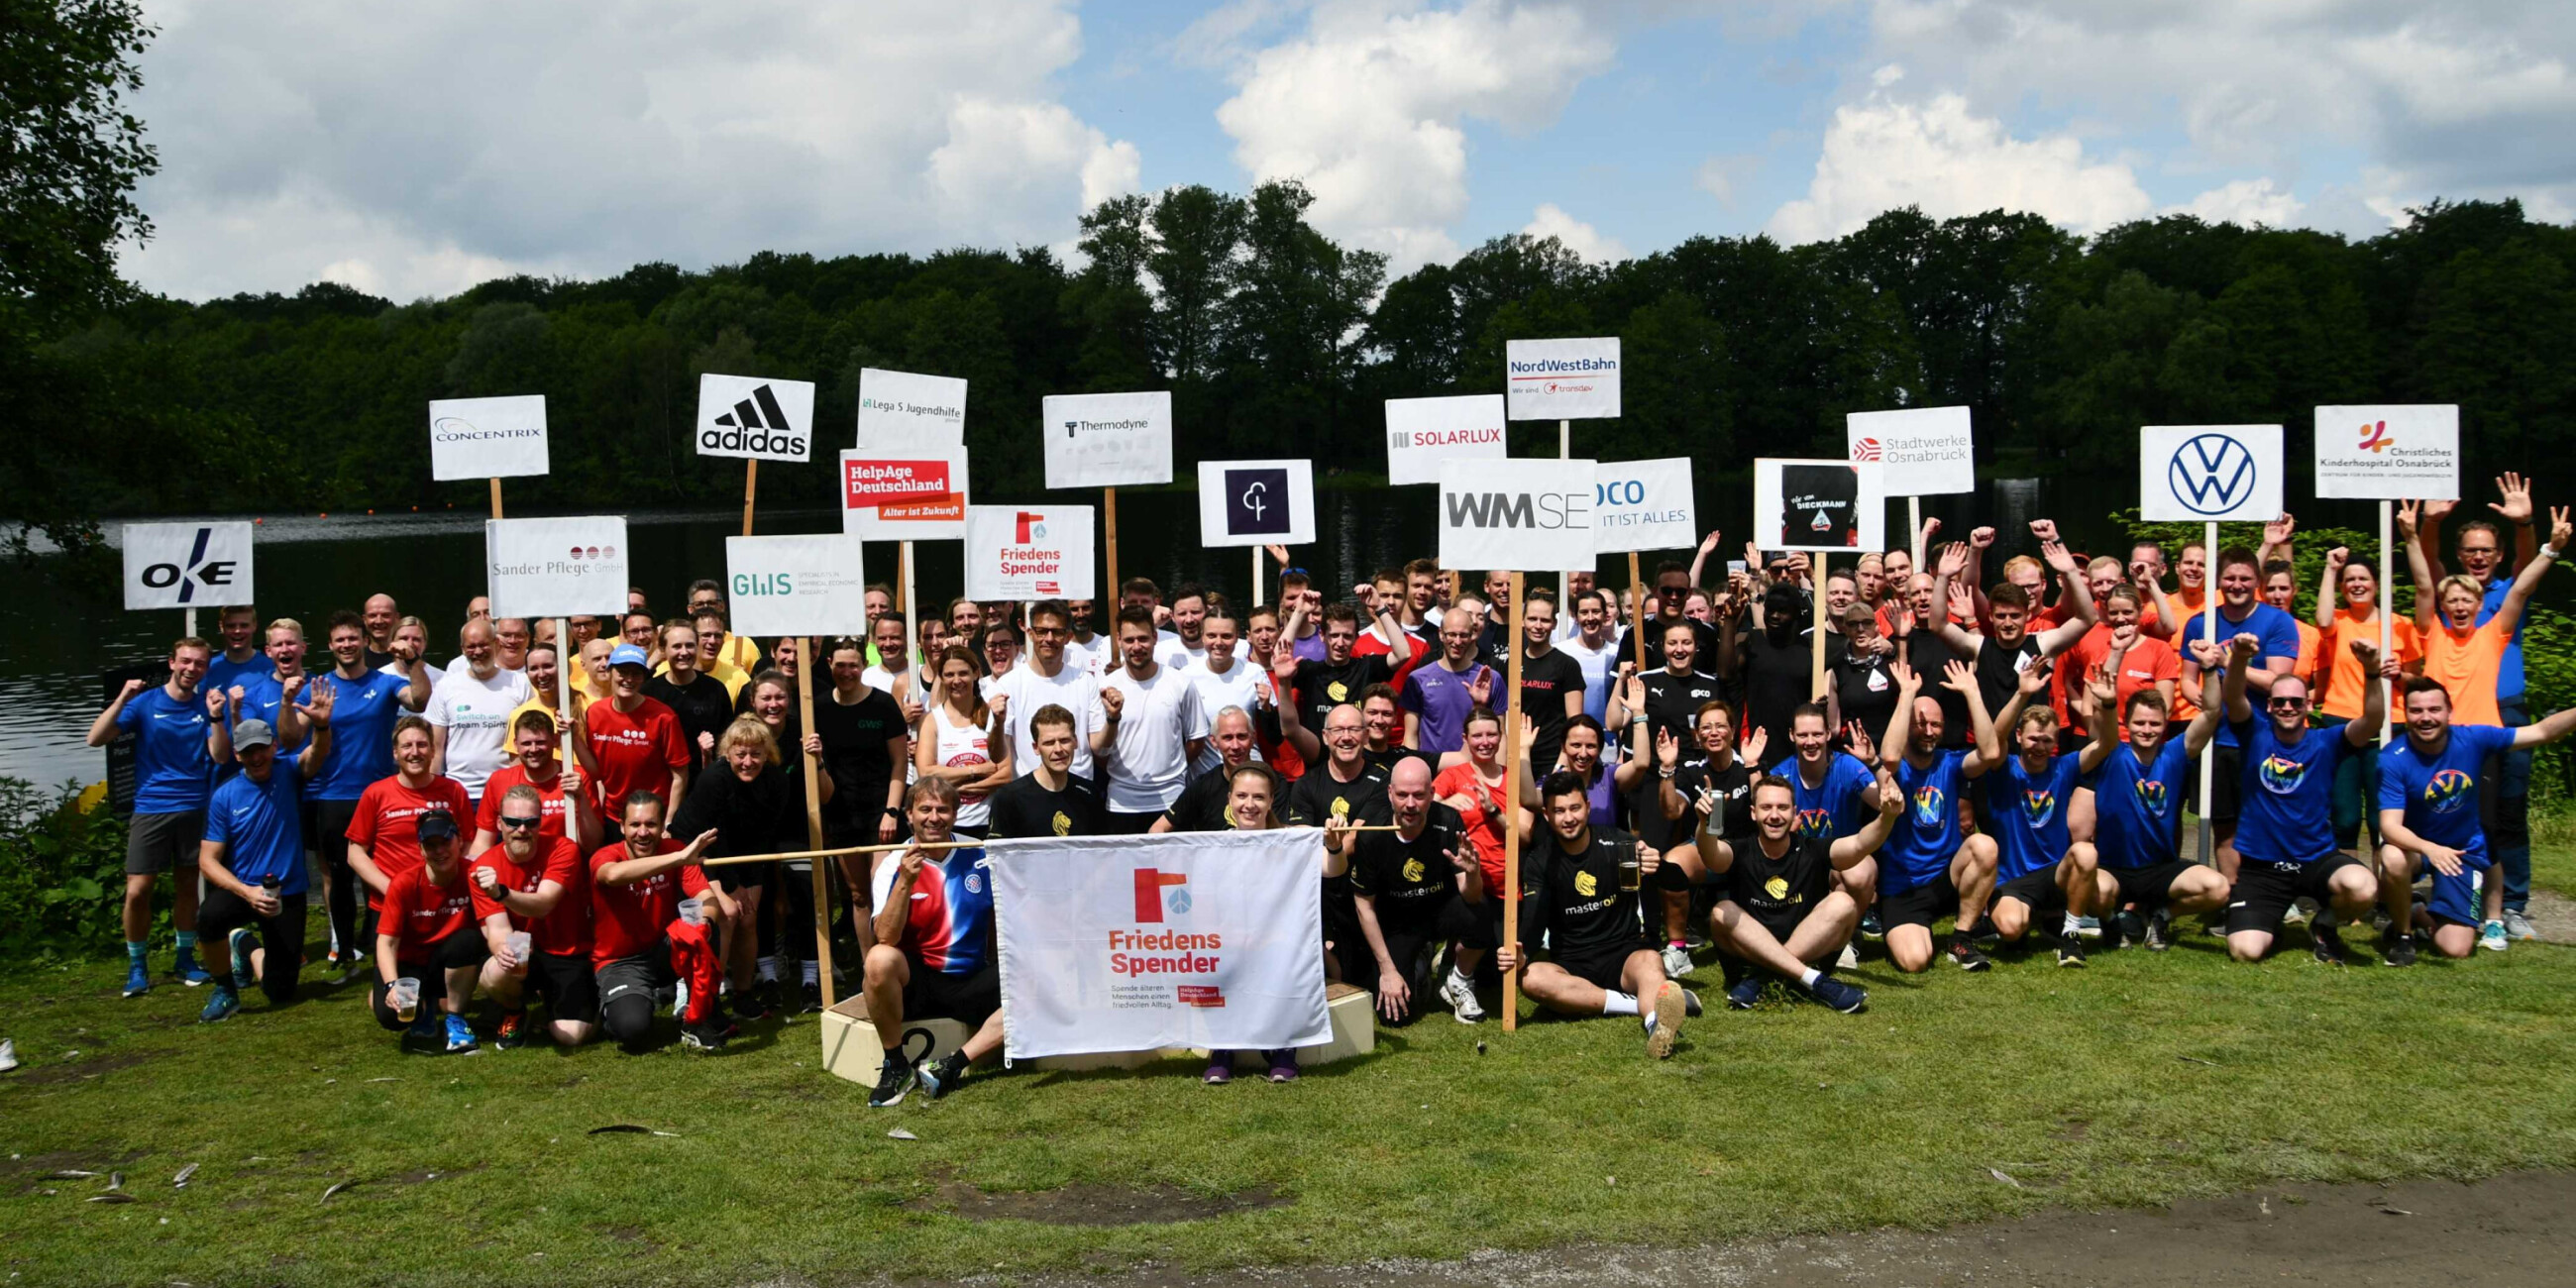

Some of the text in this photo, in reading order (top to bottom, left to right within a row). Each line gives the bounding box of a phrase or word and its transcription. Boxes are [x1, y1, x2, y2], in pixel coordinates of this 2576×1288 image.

[1511, 358, 1617, 374] NordWestBahn
[873, 399, 961, 418] Lega S Jugendhilfe
[1080, 419, 1148, 431] Thermodyne
[436, 429, 541, 442] CONCENTRIX
[701, 426, 806, 456] adidas
[1414, 429, 1501, 447] SOLARLUX
[1886, 435, 1967, 451] Stadtwerke
[1887, 448, 1967, 464] Osnabrück
[2390, 447, 2452, 457] Christliches
[2319, 459, 2452, 470] Kinderhospital Osnabrück
[851, 466, 912, 481] HelpAge
[851, 478, 944, 494] Deutschland
[883, 505, 960, 517] Alter ist Zukunft
[1797, 500, 1847, 510] DIECKMANN
[1618, 513, 1640, 526] IST
[1642, 509, 1690, 524] ALLES.
[1000, 547, 1061, 561] Friedens
[492, 562, 624, 578] Sander Pflege GmbH
[1001, 561, 1060, 577] Spender
[1521, 680, 1554, 690] LARLUX
[1564, 894, 1617, 915] masteroil
[1750, 893, 1803, 909] mastoil
[1109, 929, 1222, 951] Friedens
[1111, 951, 1221, 978] Spender
